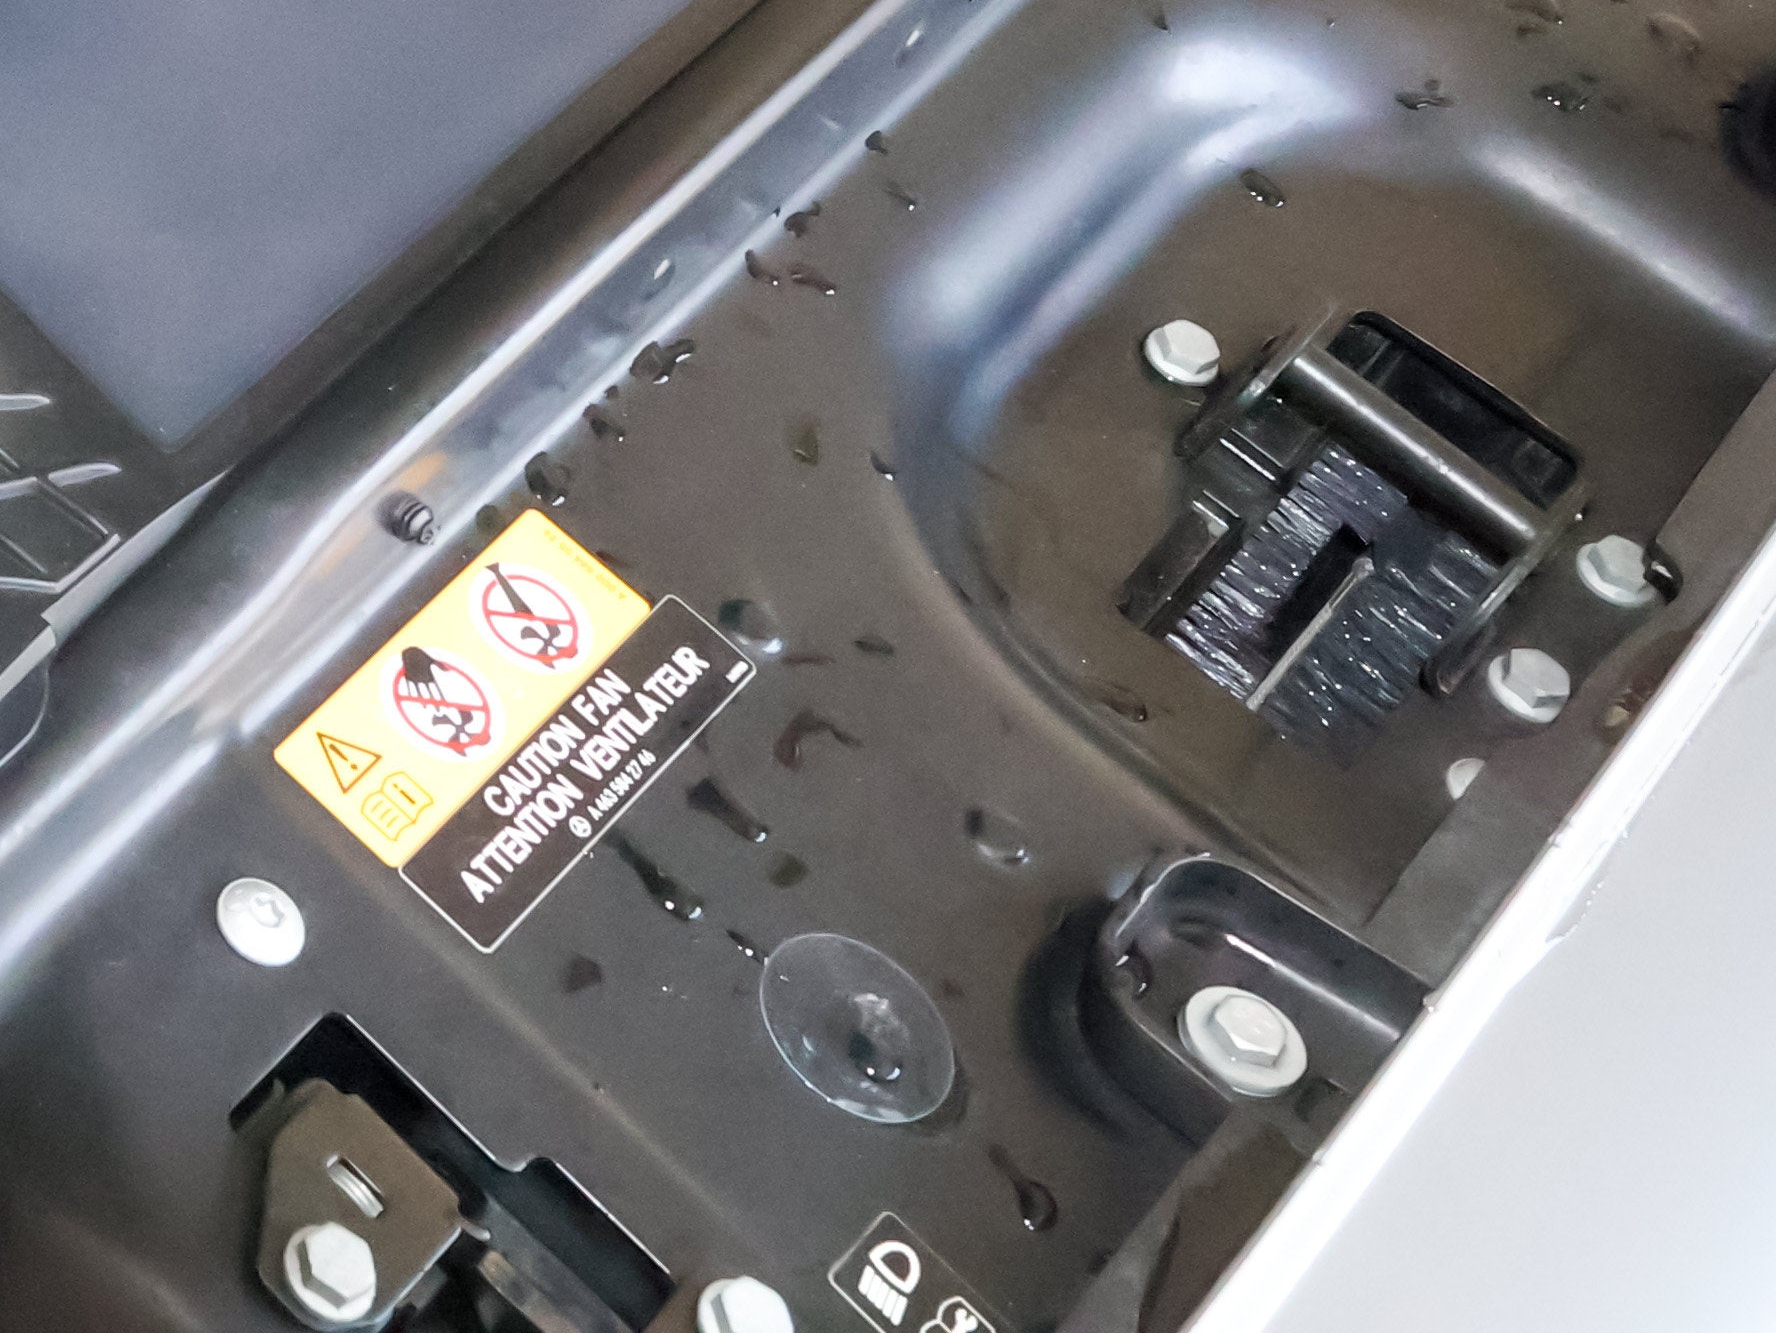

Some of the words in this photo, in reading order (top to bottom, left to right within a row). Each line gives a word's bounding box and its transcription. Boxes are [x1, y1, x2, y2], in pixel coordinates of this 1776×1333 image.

[461, 774, 584, 903] ATTENTION
[570, 646, 710, 780] VENTILATEUR
[484, 715, 585, 816] CAUTION
[572, 669, 631, 726] FAN
[587, 805, 603, 821] A
[595, 787, 618, 813] 463
[626, 759, 643, 779] 27
[638, 749, 656, 767] 46
